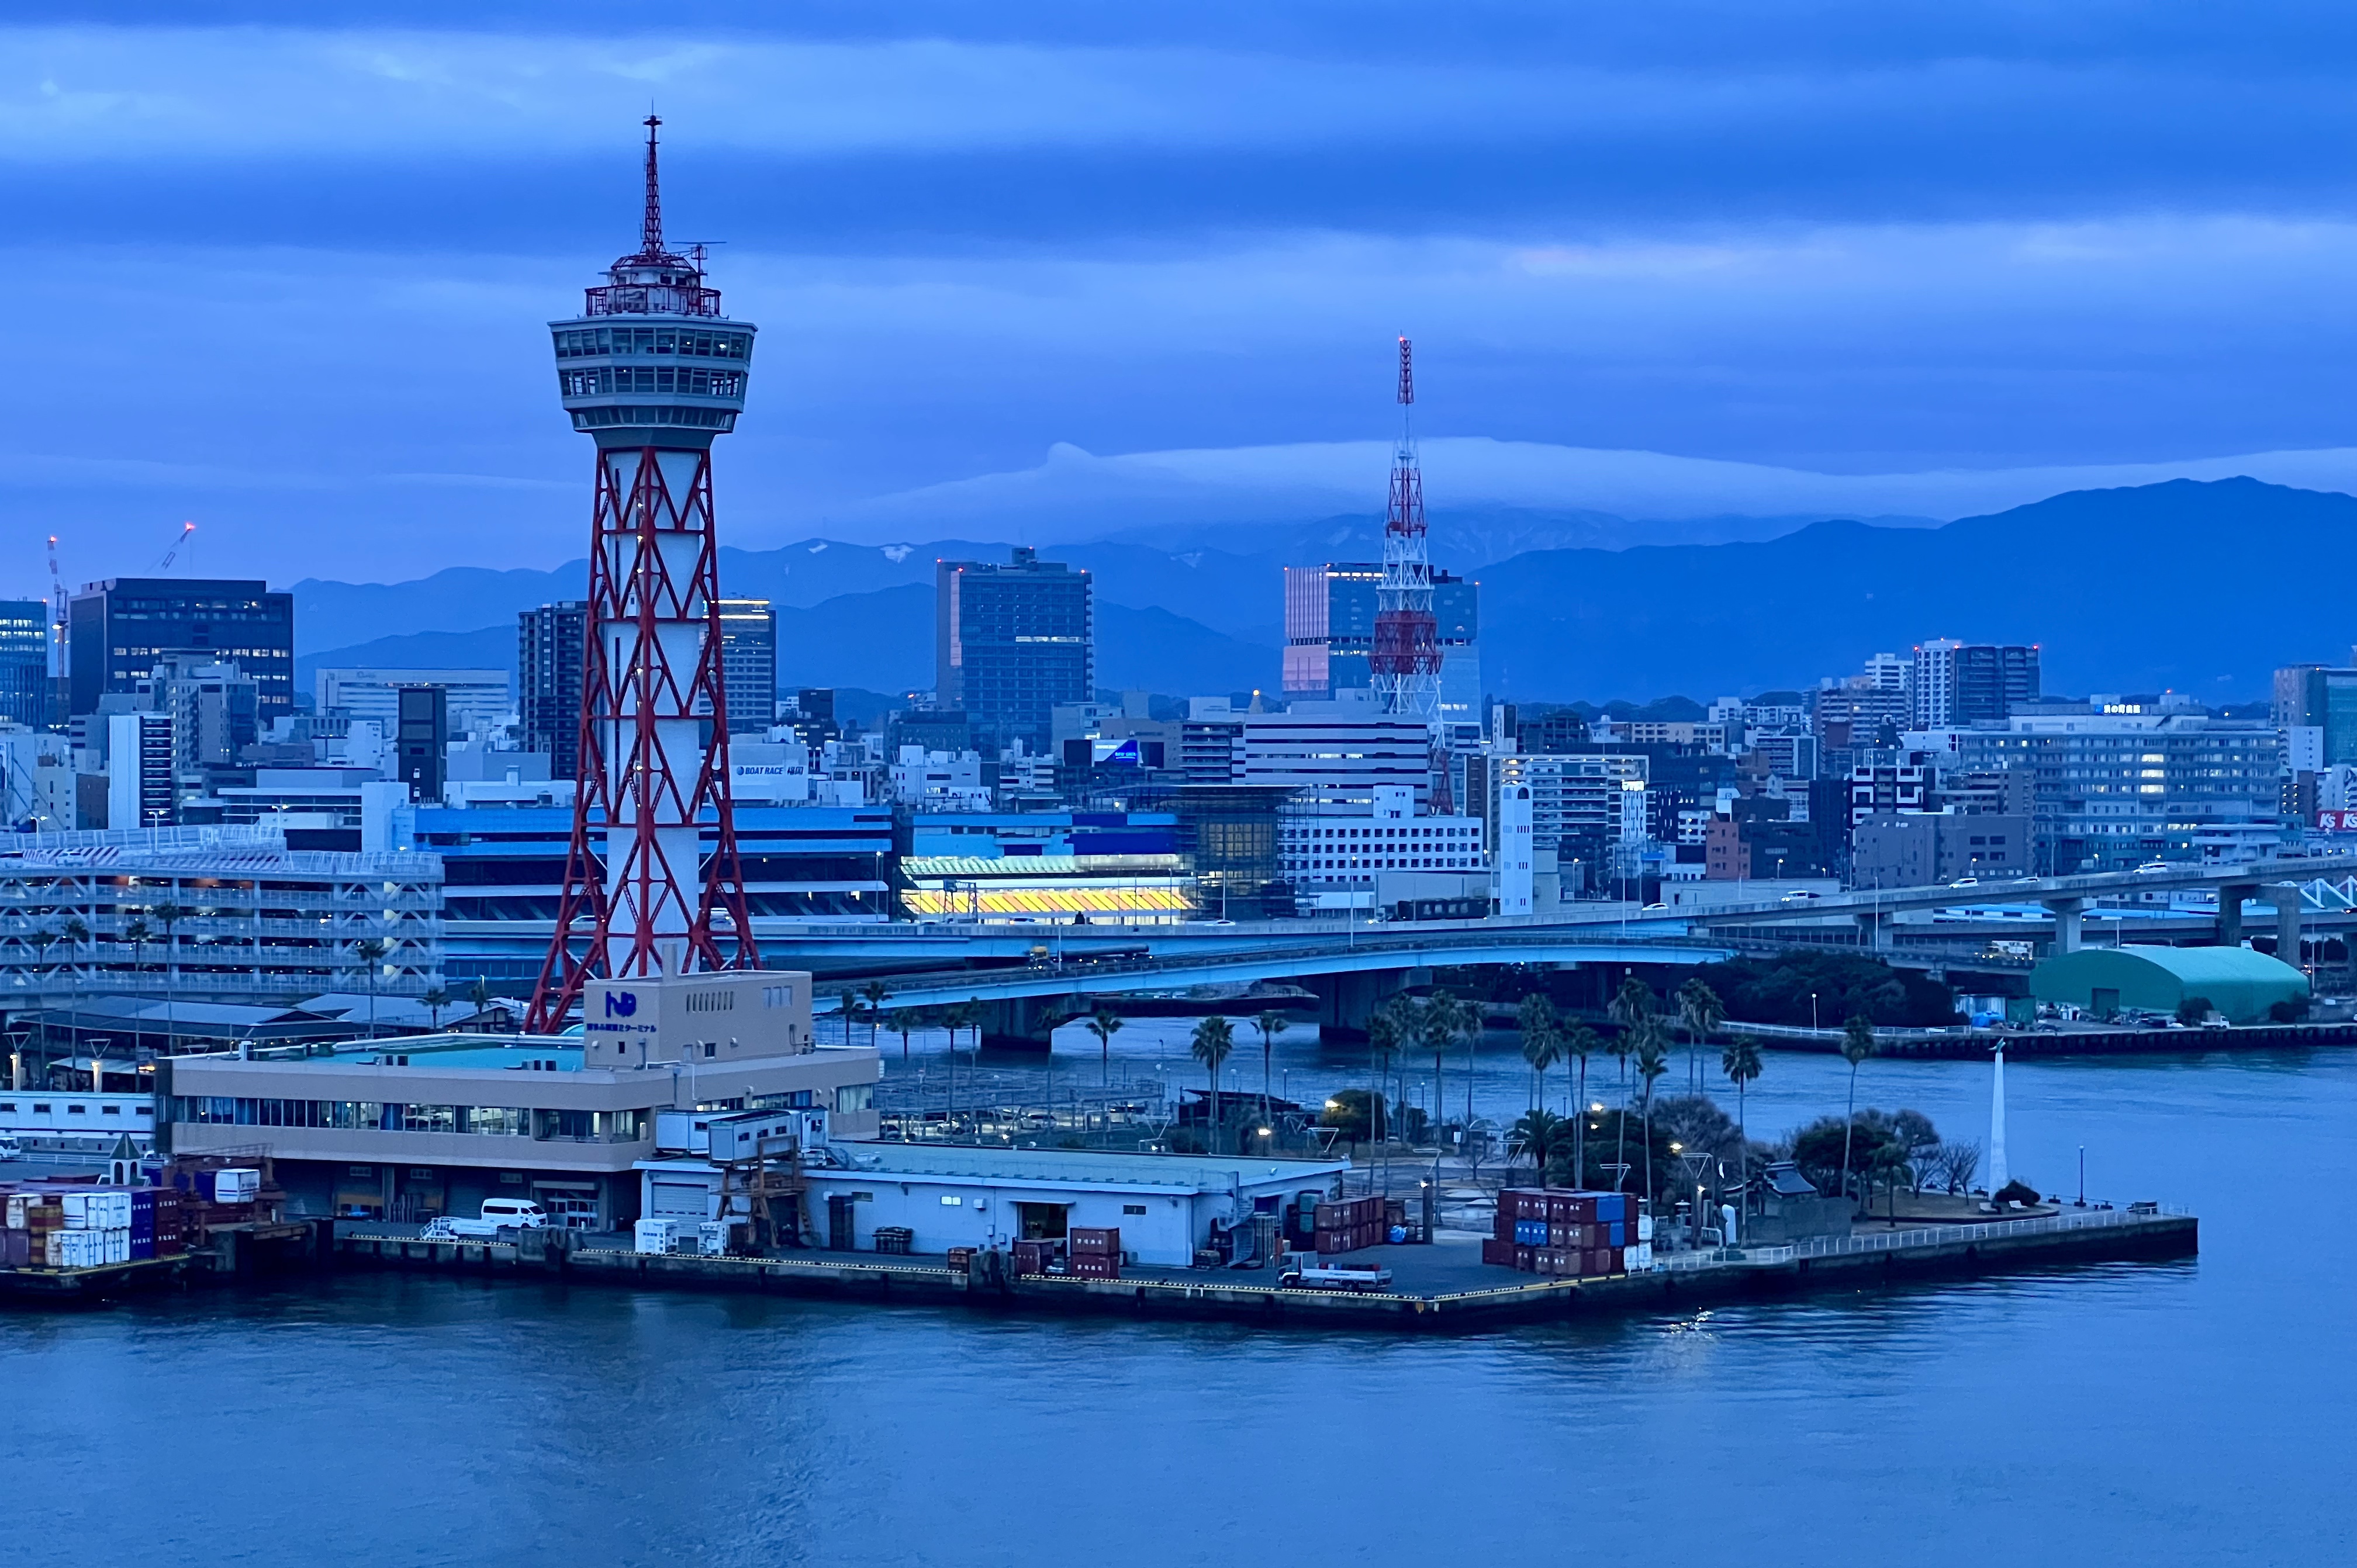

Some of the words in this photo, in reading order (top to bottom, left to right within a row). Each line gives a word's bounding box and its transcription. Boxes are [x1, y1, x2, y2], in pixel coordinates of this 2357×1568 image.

[745, 767, 763, 775] BOAT
[764, 767, 784, 775] RACE
[128, 875, 141, 894] 5
